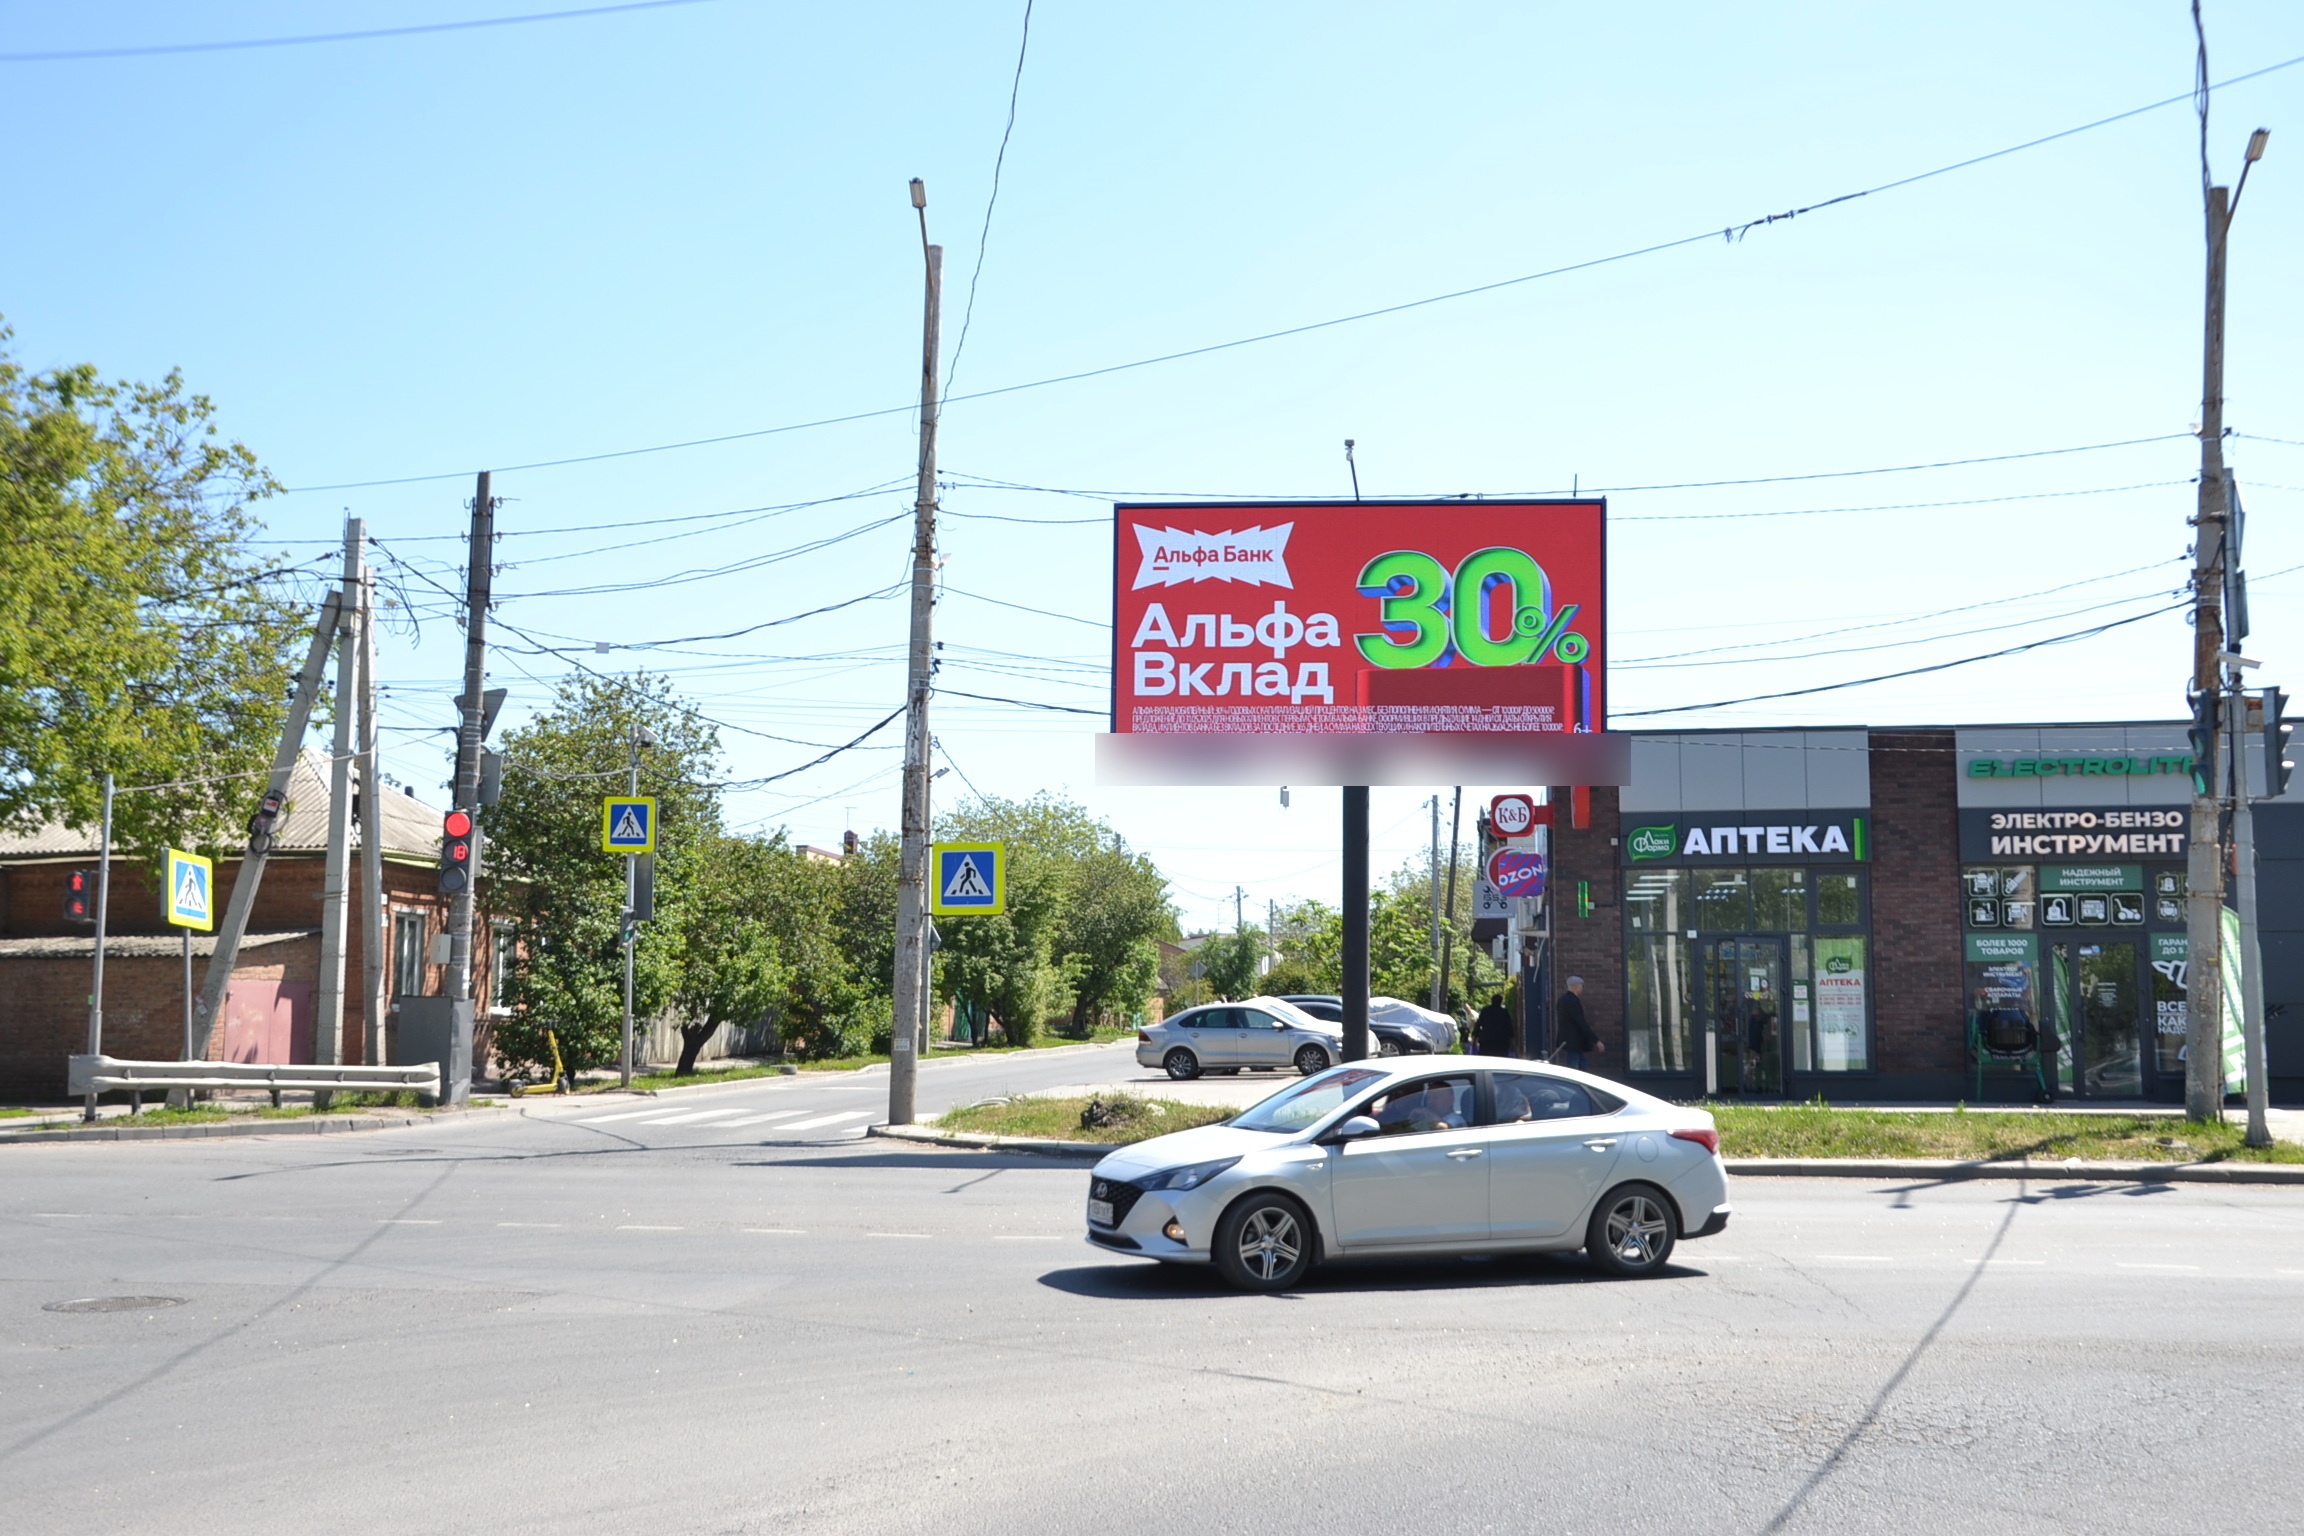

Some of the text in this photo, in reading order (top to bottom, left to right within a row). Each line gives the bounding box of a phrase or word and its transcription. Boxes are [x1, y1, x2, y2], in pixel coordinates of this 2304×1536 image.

[1153, 545, 1274, 567] Альфа Банк
[1353, 546, 1590, 669] 30%
[1130, 600, 1341, 659] Альфа
[1134, 651, 1334, 704] Вклад
[1573, 722, 1592, 733] 6+
[1498, 806, 1528, 824] К&Б
[1990, 811, 2184, 829] ЭЛЕКТРО-БЕНЗО
[1683, 825, 1849, 855] АПТЕКА
[1991, 834, 2185, 855] ИНСТРУМЕНТ
[1499, 863, 1543, 886] OZON
[2062, 867, 2121, 877] НАДЕЖНЫЙ
[2059, 878, 2124, 886] ИНСТРУМЕНТ
[1976, 939, 2028, 947] БОЛЕЕ 1000
[2158, 938, 2188, 947] ГАРАН
[1980, 947, 2025, 955] ТОВАРОВ
[1819, 978, 1861, 986] АПТЕКА
[2157, 1001, 2187, 1012] ВСЕ
[2158, 1016, 2187, 1026] КАК
